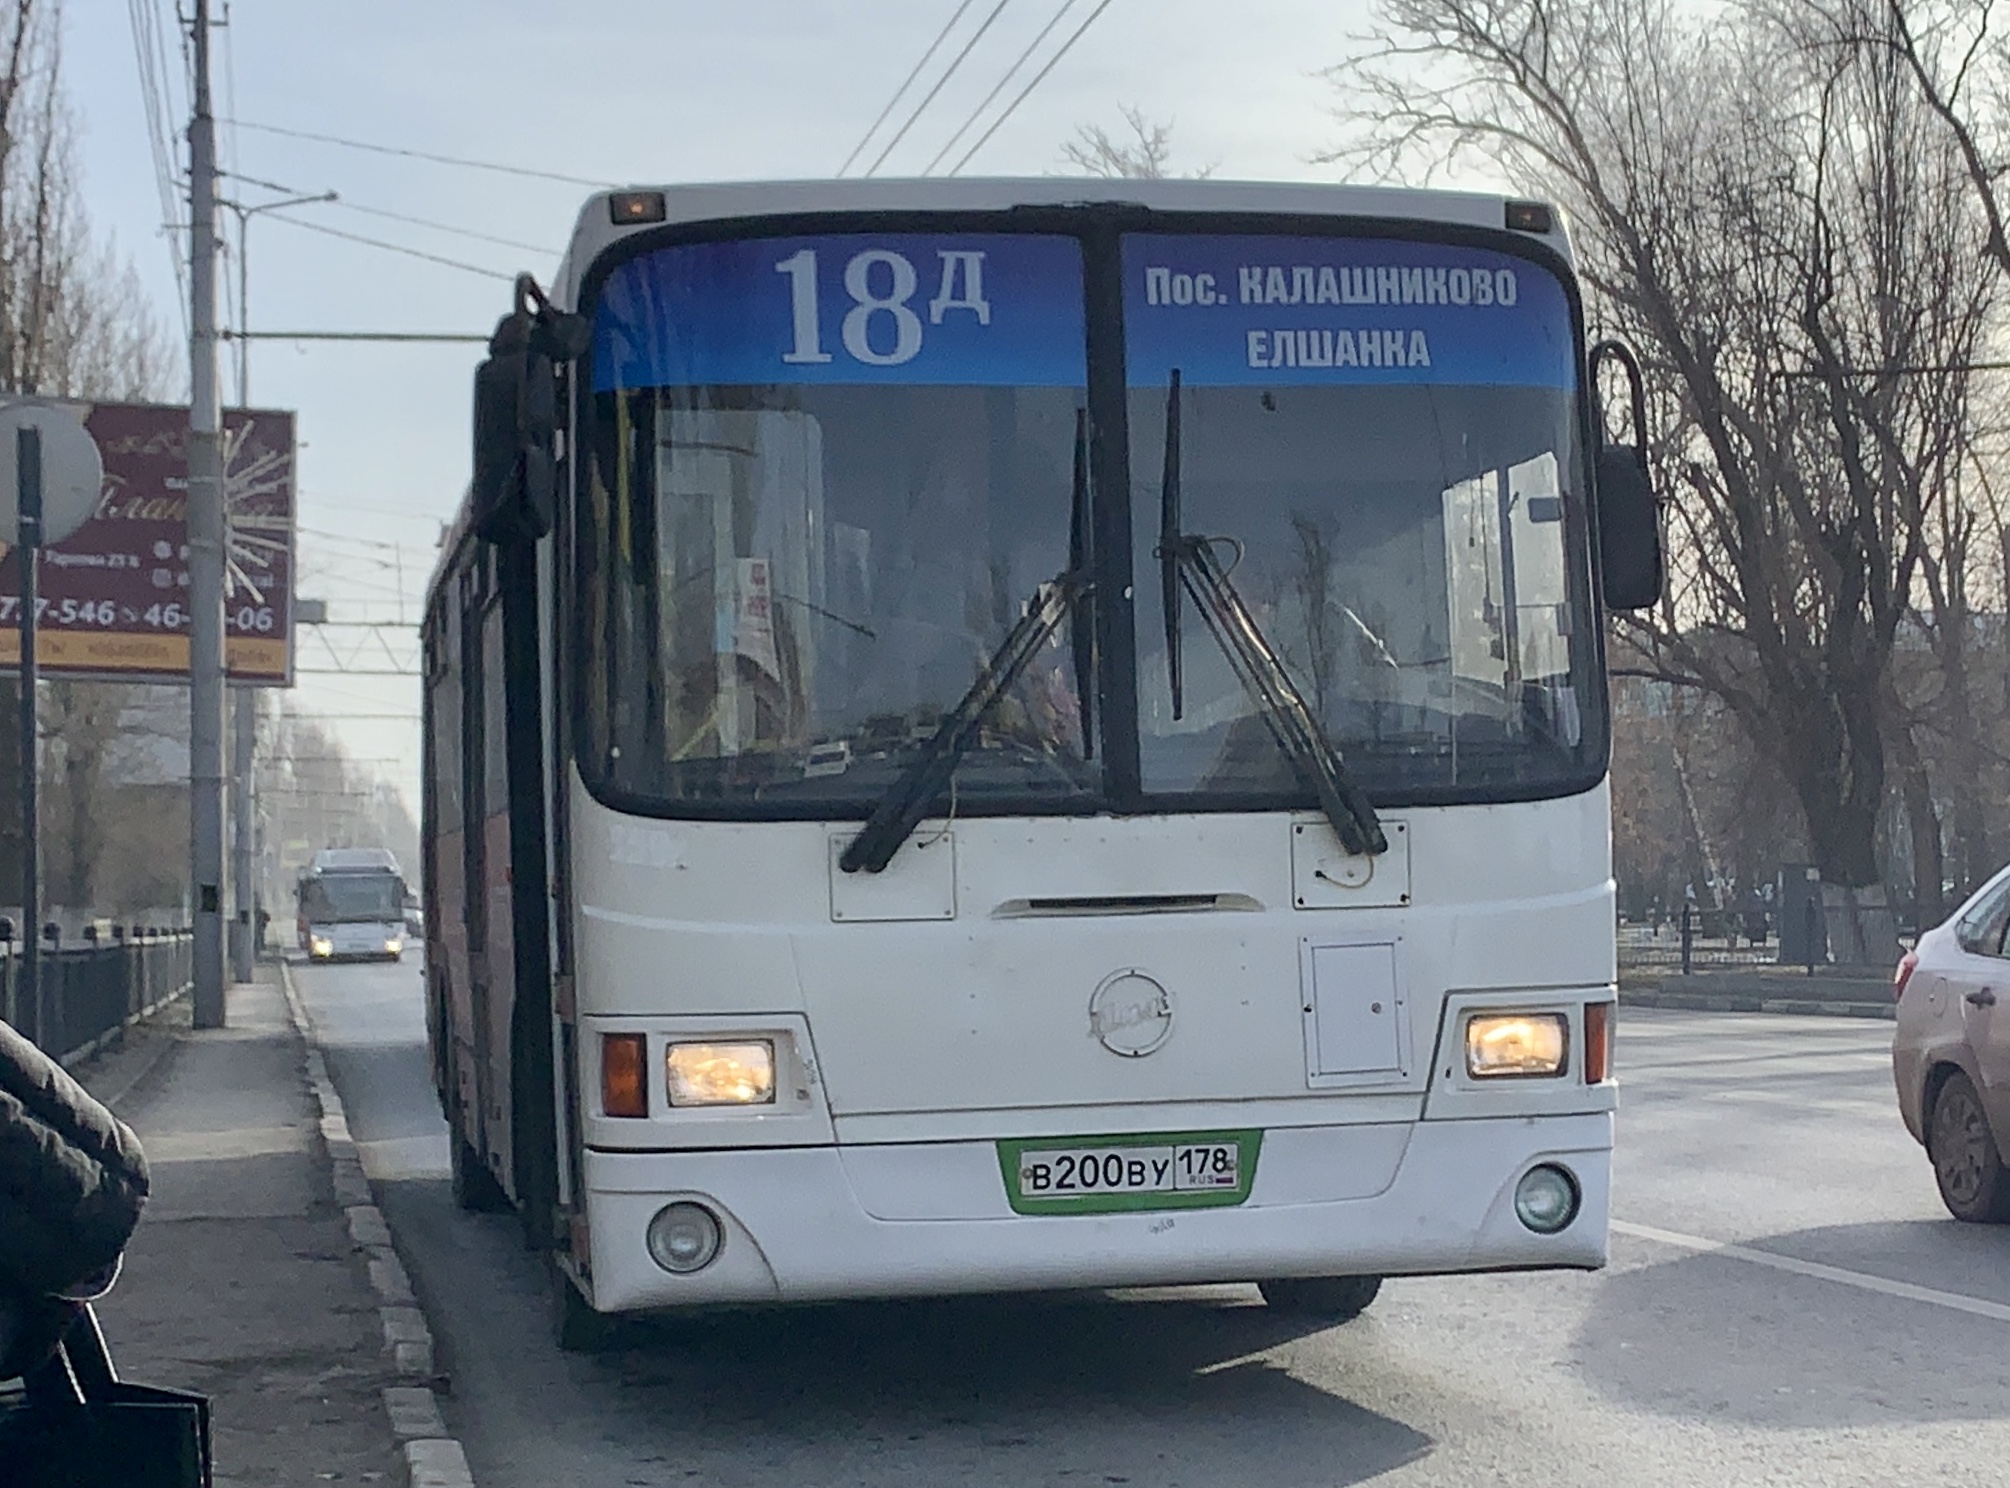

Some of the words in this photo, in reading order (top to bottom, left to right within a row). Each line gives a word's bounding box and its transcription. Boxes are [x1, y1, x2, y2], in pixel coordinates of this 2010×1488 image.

[1146, 267, 1228, 306] Пос.
[1238, 265, 1518, 307] КАЛАШНИКОВО
[1248, 330, 1432, 368] ЕЛШАНКА
[1178, 1147, 1228, 1175] 178
[1189, 1175, 1215, 1185] RUS
